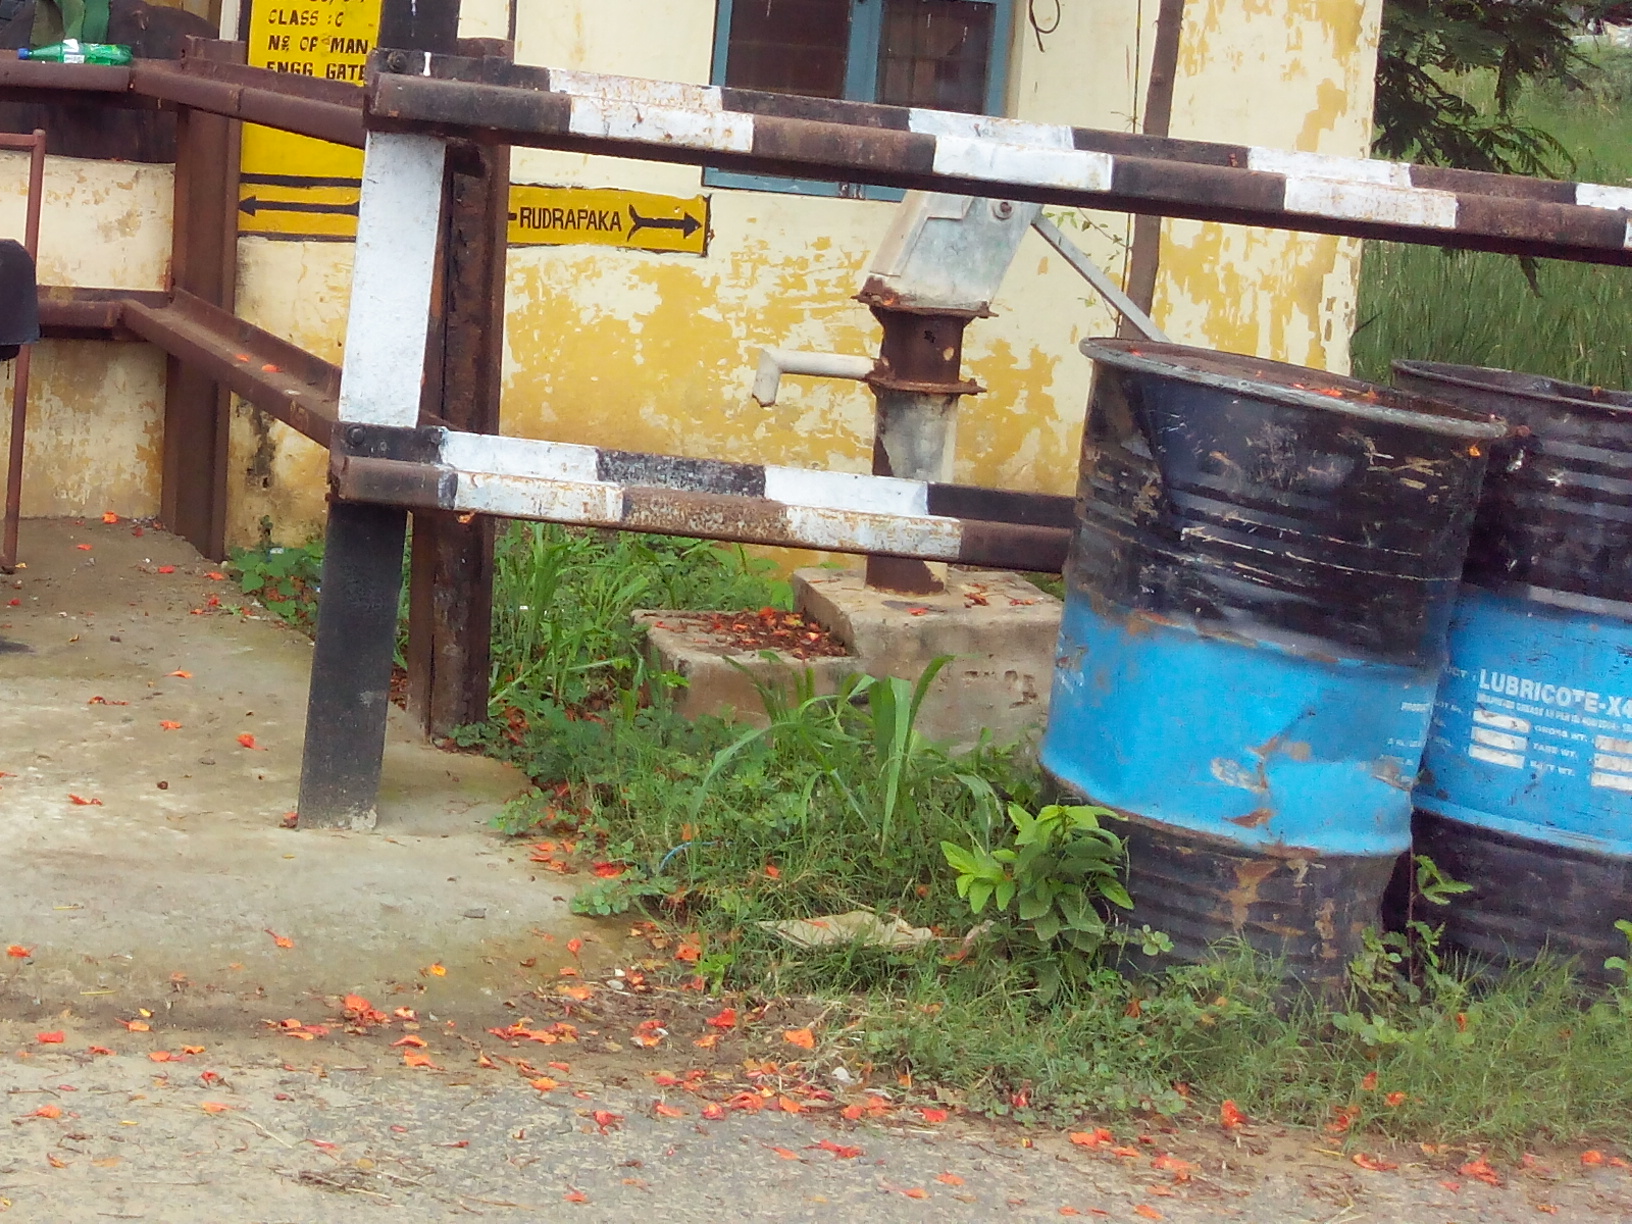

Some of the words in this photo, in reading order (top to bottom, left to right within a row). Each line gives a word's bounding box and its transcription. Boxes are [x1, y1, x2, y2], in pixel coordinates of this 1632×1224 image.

[268, 8, 320, 26] CLASS
[299, 36, 319, 52] OF
[330, 37, 369, 55] MAN
[519, 206, 623, 232] RUDRAPAKA
